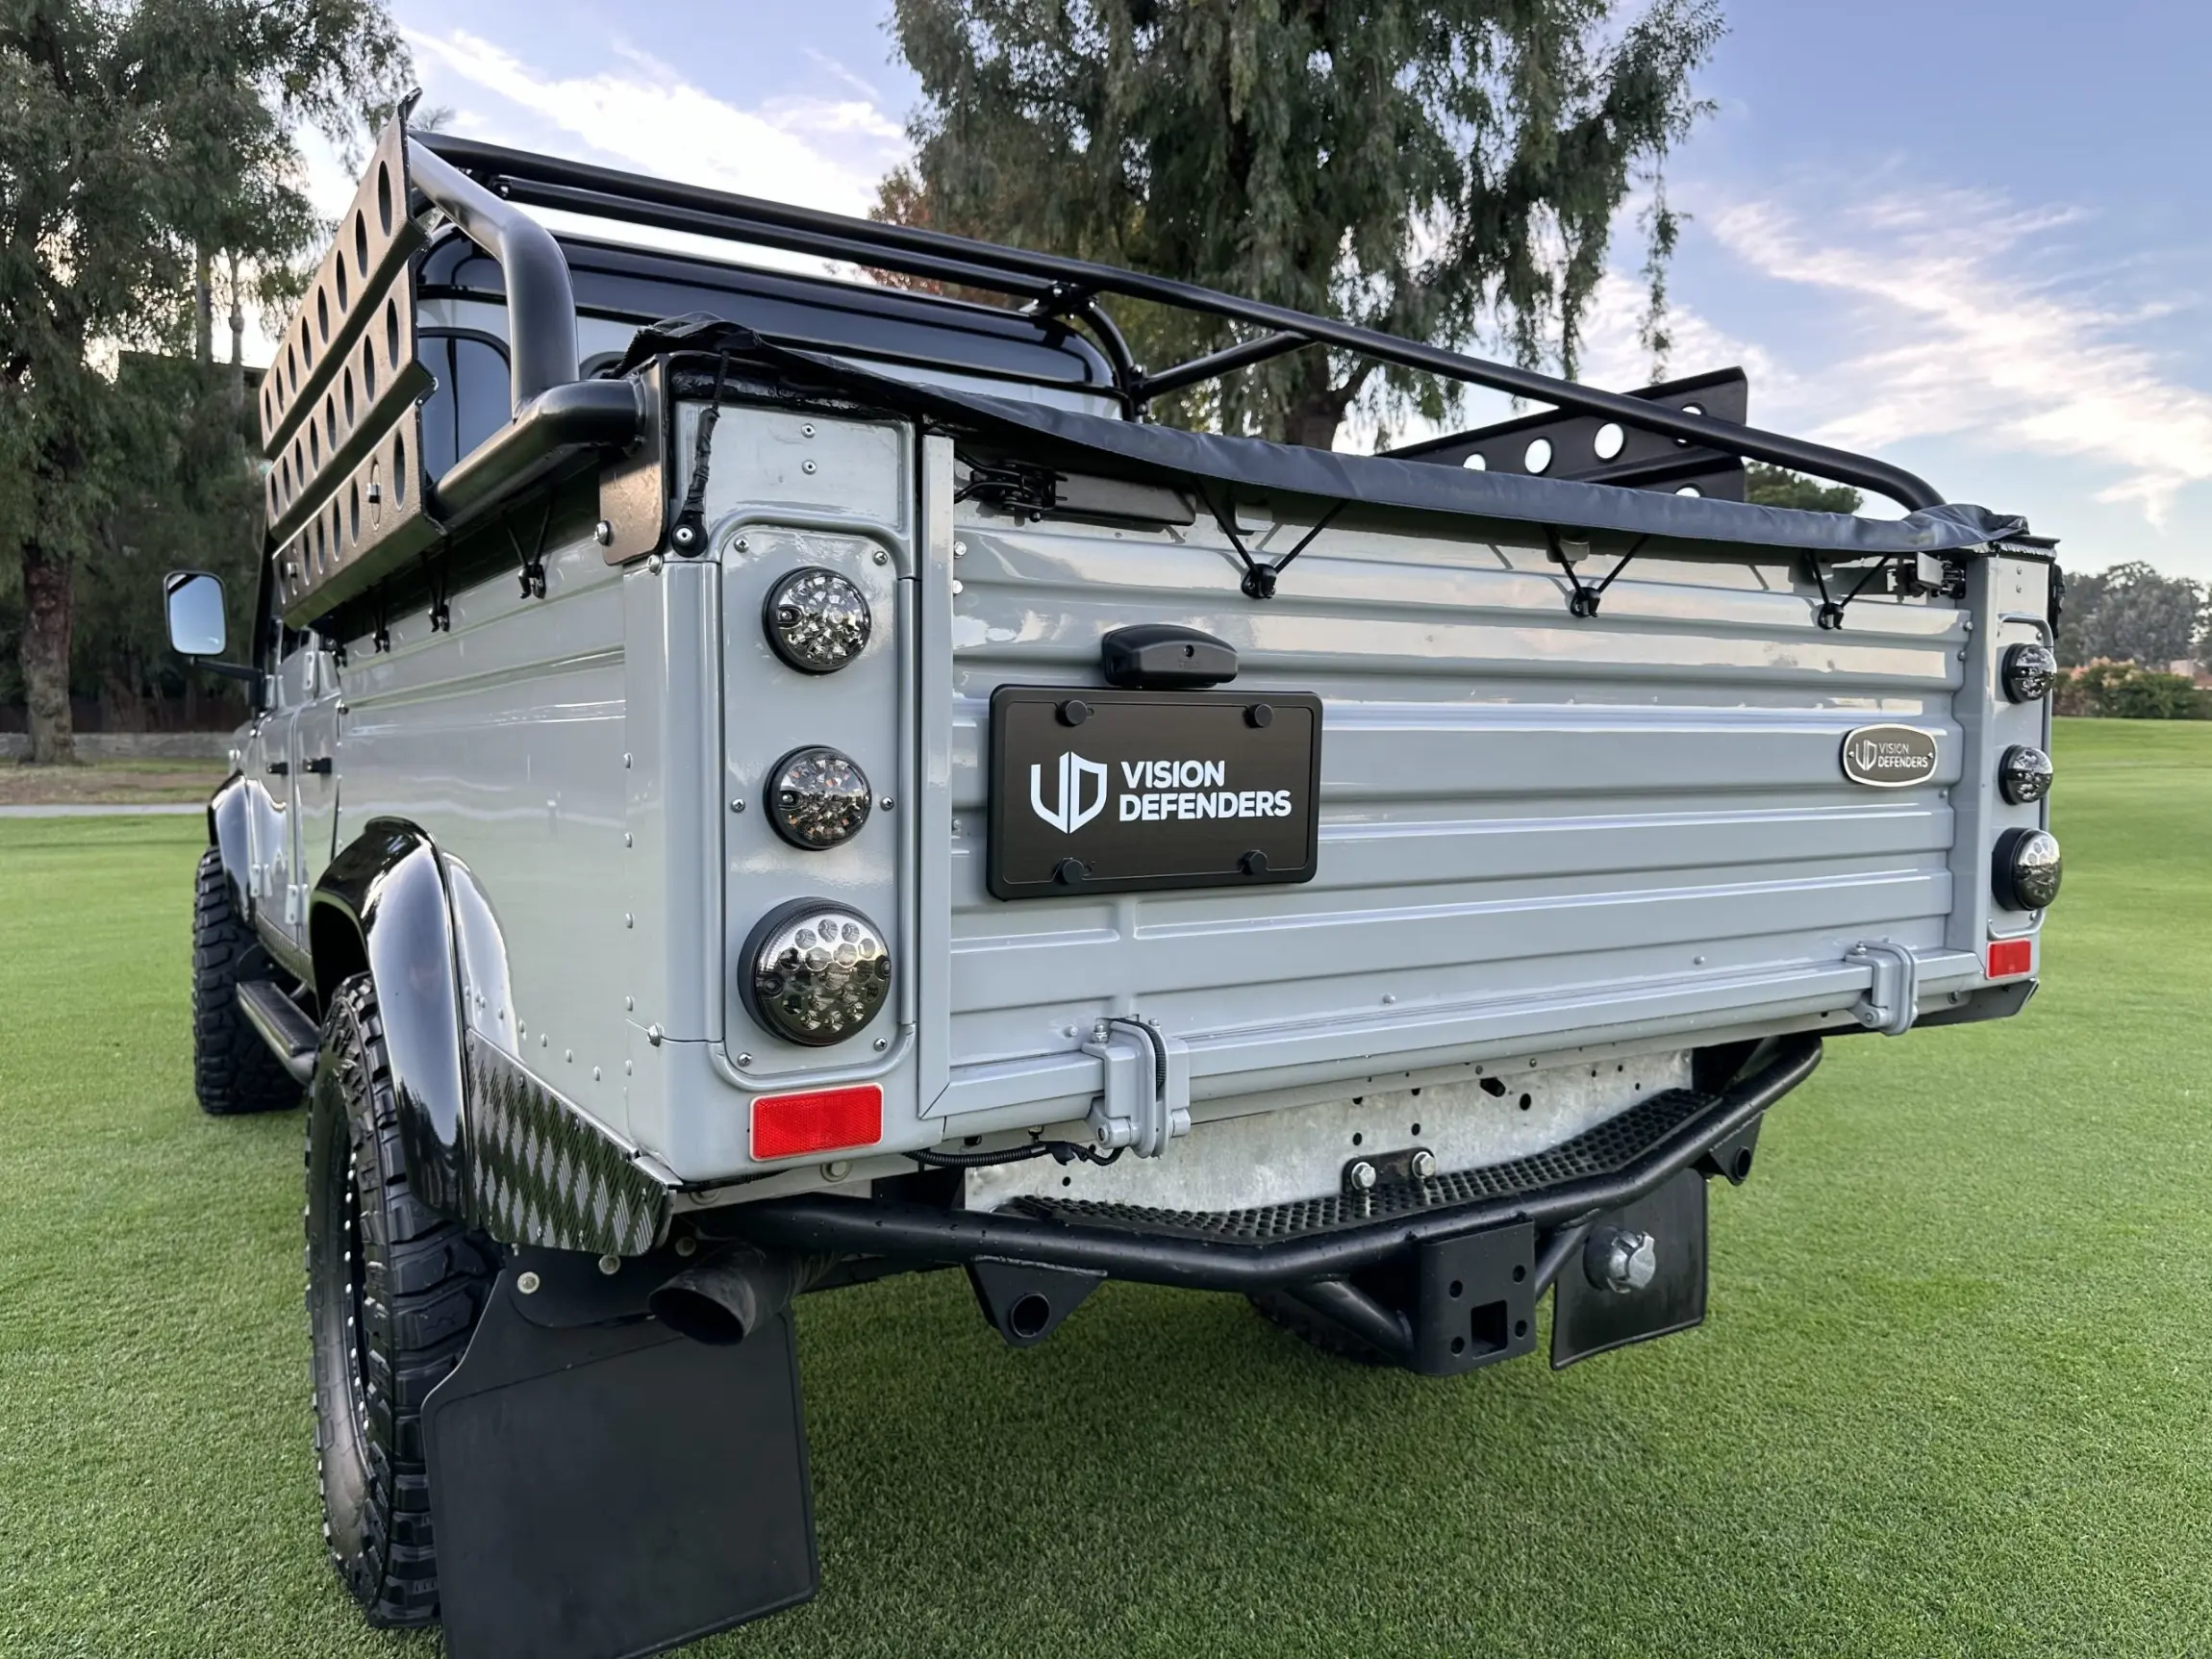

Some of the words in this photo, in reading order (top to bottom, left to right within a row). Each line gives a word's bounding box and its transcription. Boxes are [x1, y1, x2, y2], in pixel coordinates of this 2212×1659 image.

[1878, 742, 1909, 754] VISION
[1877, 755, 1929, 768] DEFENDERS
[1120, 760, 1225, 789] VISION
[1119, 790, 1292, 821] DEFENDERS
